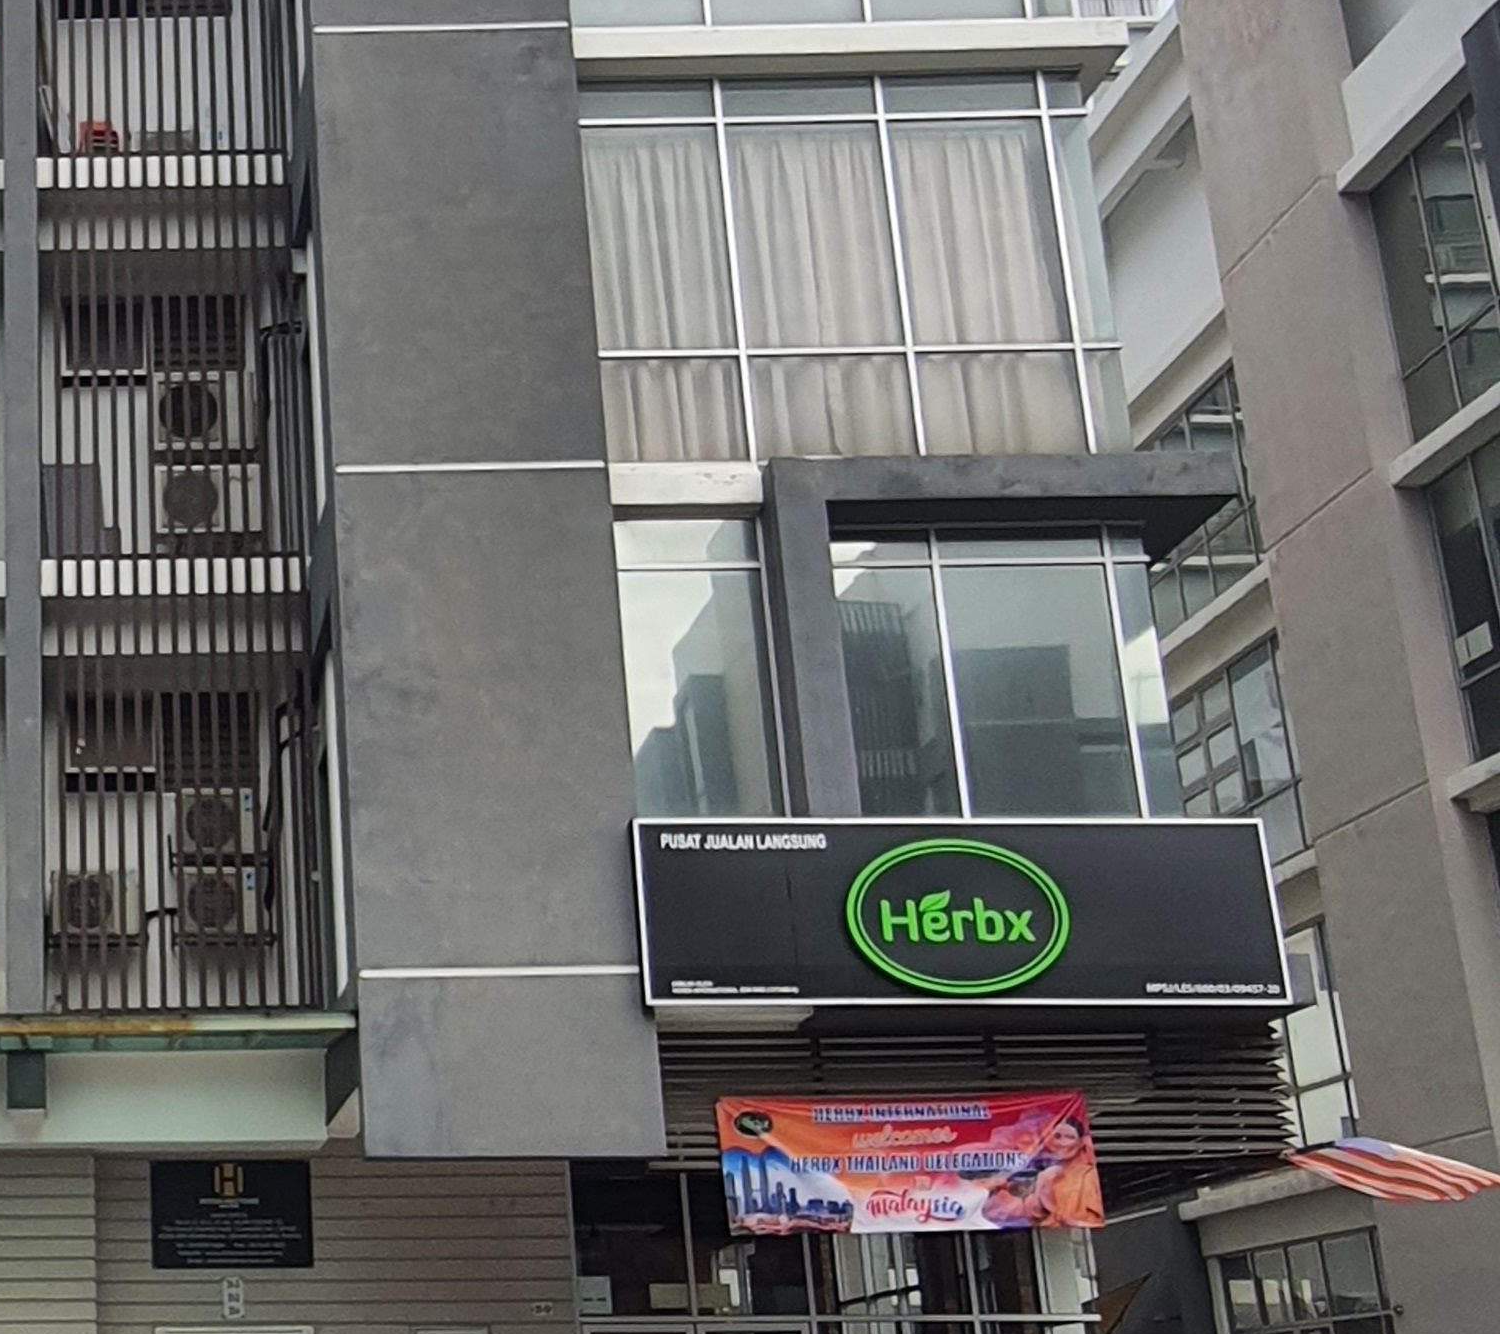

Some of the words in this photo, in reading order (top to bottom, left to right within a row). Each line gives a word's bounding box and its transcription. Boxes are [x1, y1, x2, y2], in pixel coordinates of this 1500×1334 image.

[660, 833, 701, 849] PUSAT
[704, 834, 754, 850] JUALAN
[756, 833, 827, 850] LANGSUNG
[880, 891, 1036, 943] Herbx
[868, 1104, 990, 1120] INTERNATIONAL
[789, 1156, 841, 1173] HERBX
[845, 1154, 920, 1171] THAILAND
[924, 1152, 1026, 1170] DELEGATIONS
